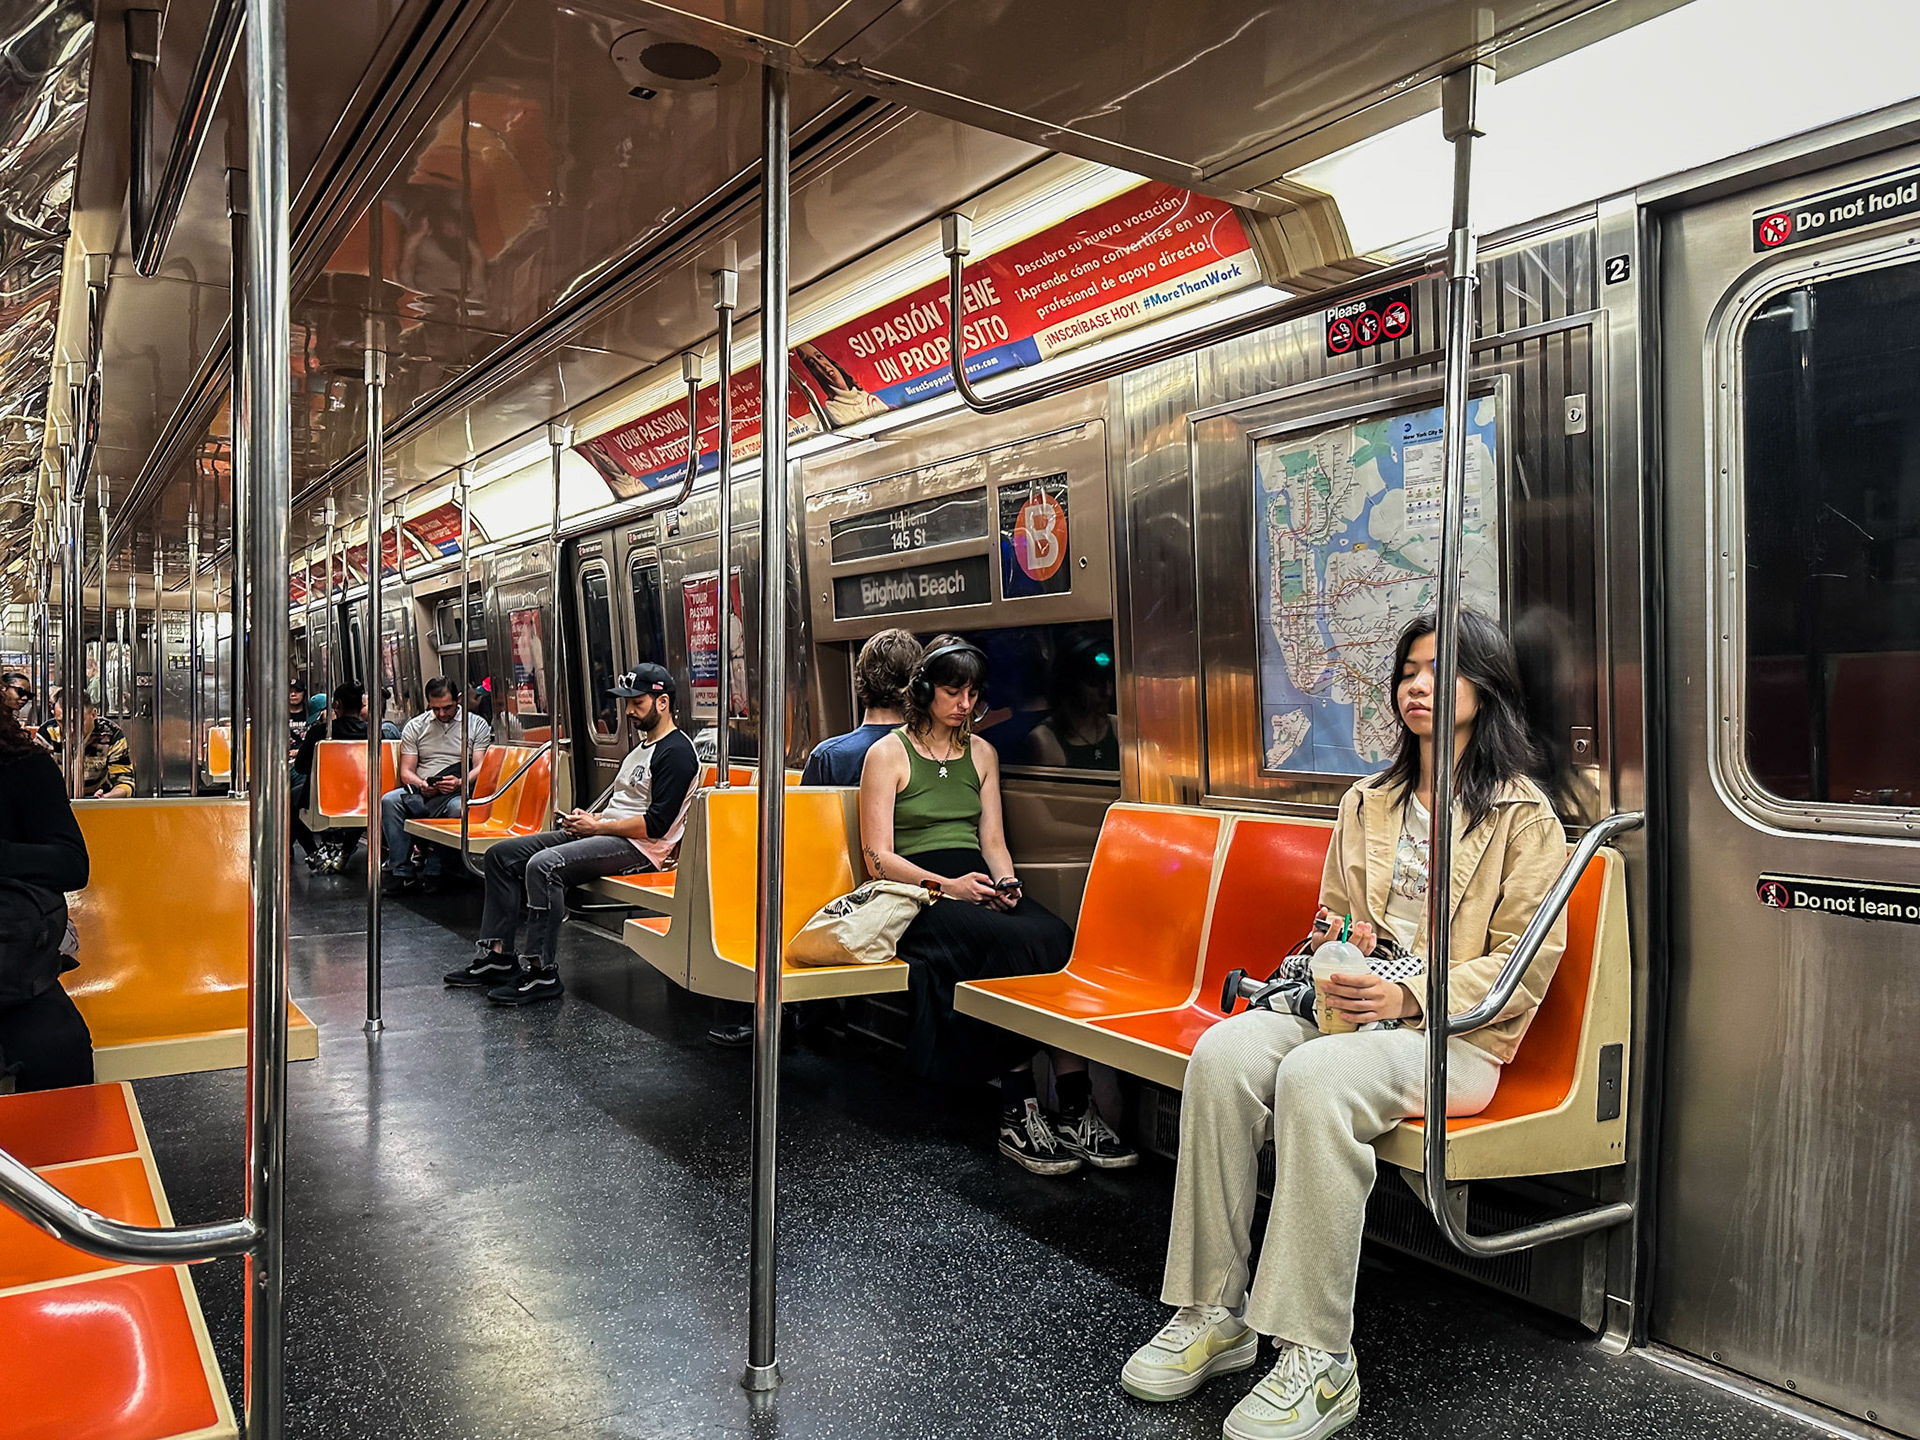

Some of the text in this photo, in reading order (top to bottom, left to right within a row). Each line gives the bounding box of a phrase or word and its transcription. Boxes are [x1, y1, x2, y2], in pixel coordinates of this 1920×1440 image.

[1796, 182, 1918, 232] Do not hold
[1014, 195, 1182, 277] Descubra su nueva vocación
[1014, 208, 1215, 303] ¡Aprenda cómo convertirse en un
[1036, 233, 1212, 320] profesional de apoyo directo!
[1610, 259, 1625, 281] 2
[848, 276, 1002, 358] SU PASIÓN TENE
[1044, 263, 1243, 349] ¡INSCRÍBASE HOY! #MoreThanWork
[1326, 301, 1367, 323] Please
[874, 315, 1009, 383] UN PROPSITO
[735, 381, 755, 394] Your
[744, 397, 756, 408] As
[612, 408, 689, 452] YOUR PASSION
[626, 451, 653, 472] HAS
[648, 448, 662, 467] A
[889, 509, 928, 531] Harlem
[890, 527, 927, 550] 145 St
[1025, 503, 1059, 571] B
[861, 569, 966, 607] Brighton Beach
[1793, 890, 1920, 919] Do not lean o
